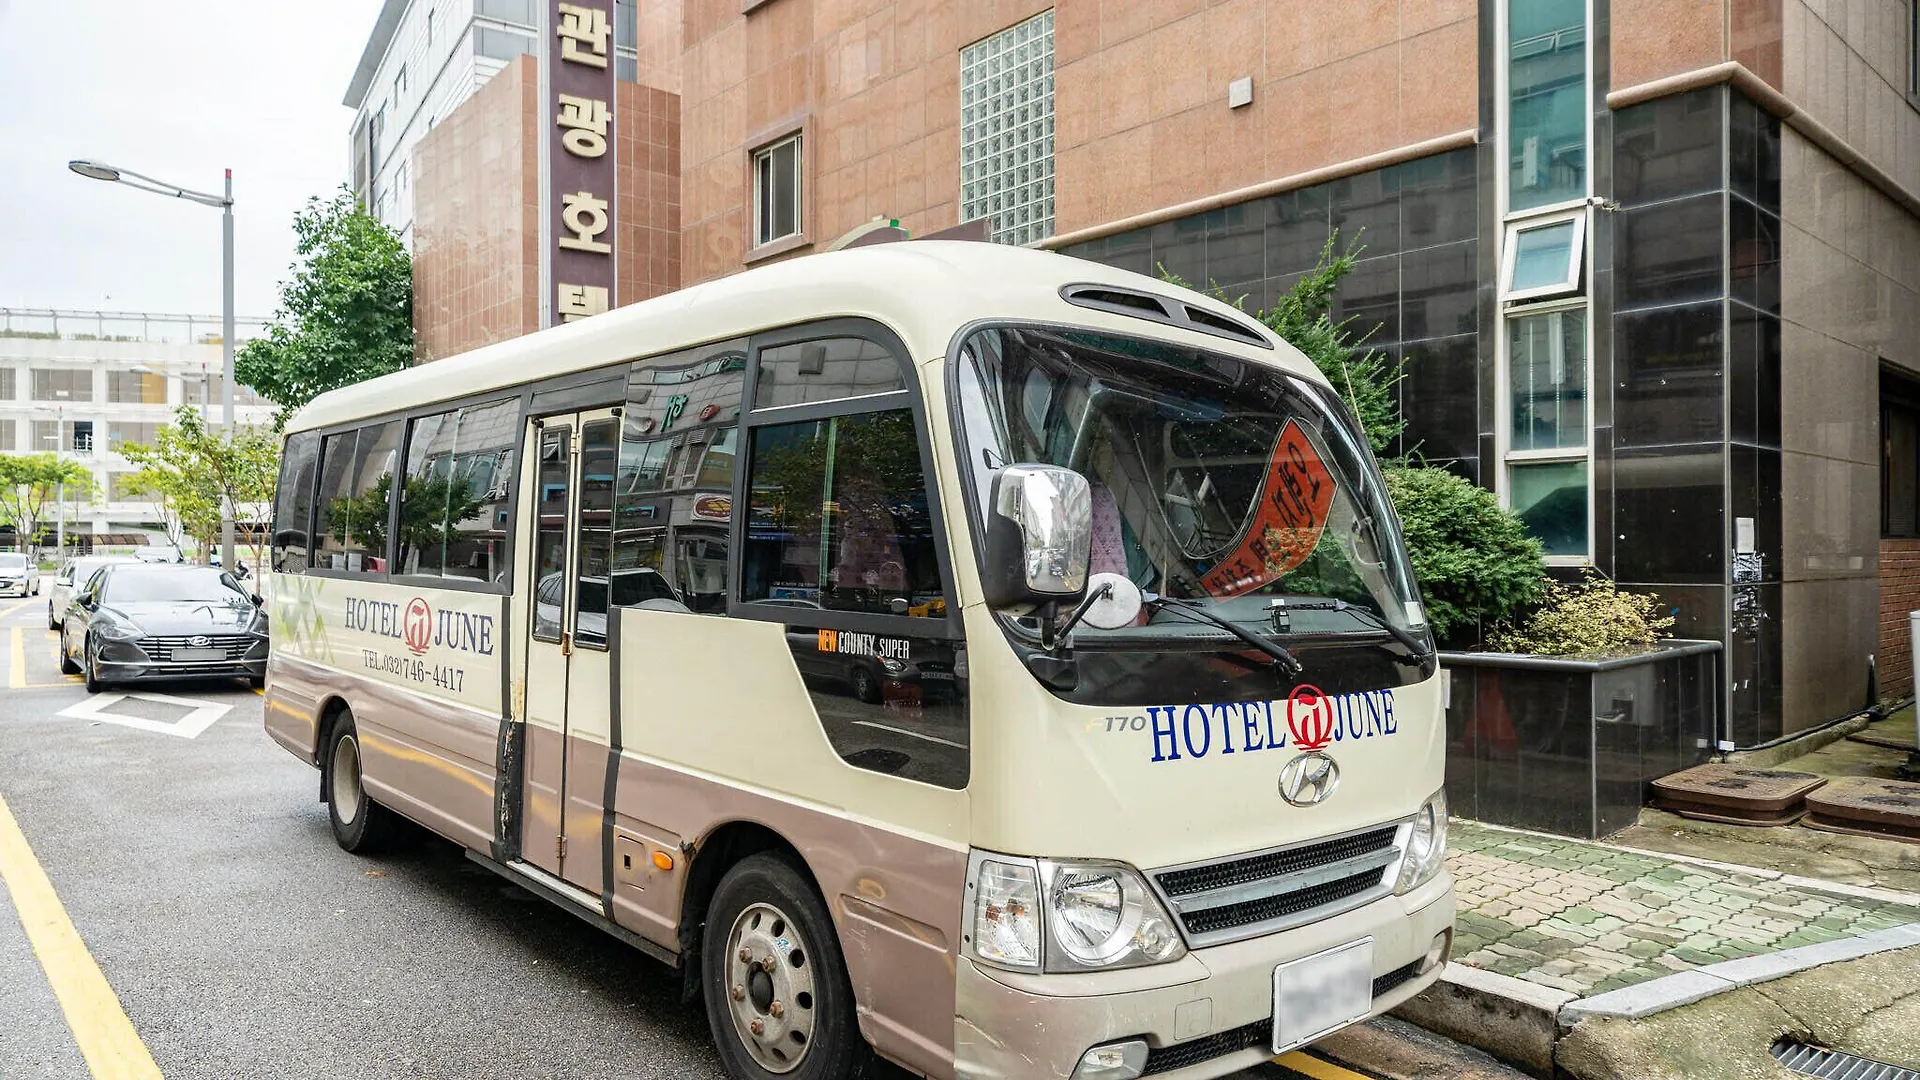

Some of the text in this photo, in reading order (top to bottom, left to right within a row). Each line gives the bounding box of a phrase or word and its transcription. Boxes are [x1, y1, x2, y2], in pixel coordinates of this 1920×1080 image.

[345, 597, 494, 656] HOTEL JUNE
[818, 629, 910, 660] NEW COUNTY SUPER
[362, 649, 464, 693] TEL.032)746-4417
[1146, 689, 1398, 763] HOTEL JUNE
